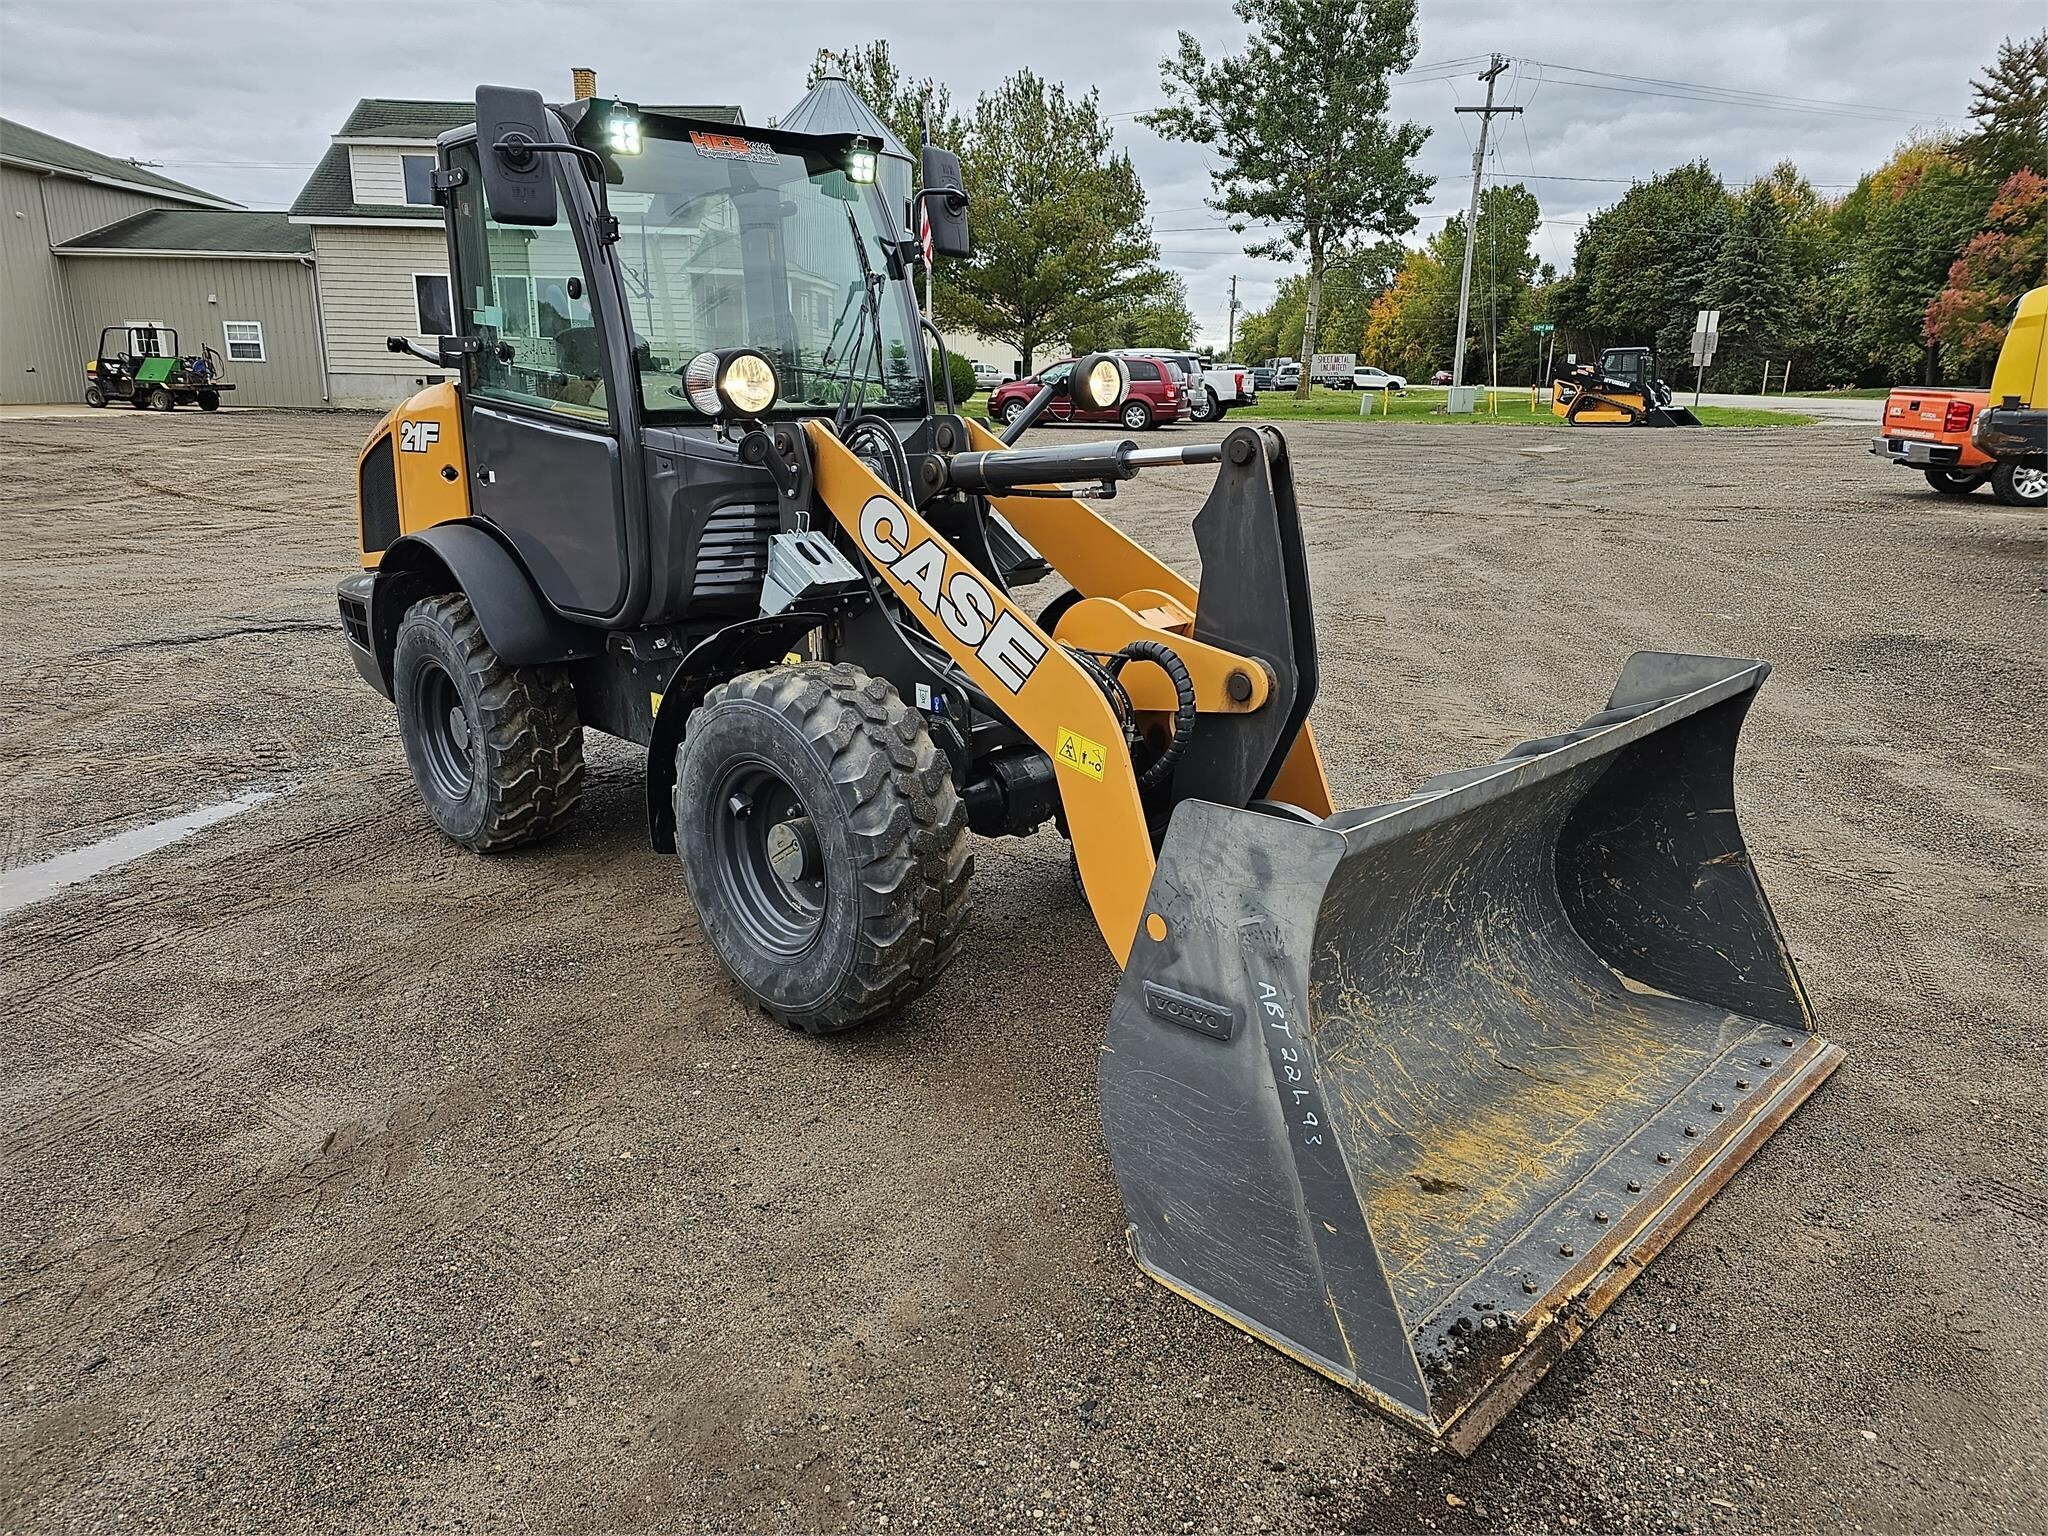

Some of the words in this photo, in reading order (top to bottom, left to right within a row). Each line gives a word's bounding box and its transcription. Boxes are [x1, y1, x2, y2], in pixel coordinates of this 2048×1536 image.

[689, 131, 751, 153] HES
[1604, 377, 1630, 388] HYUNDAI
[401, 420, 440, 453] 21F
[859, 495, 1050, 695] CASE
[1152, 995, 1220, 1029] VOLVO
